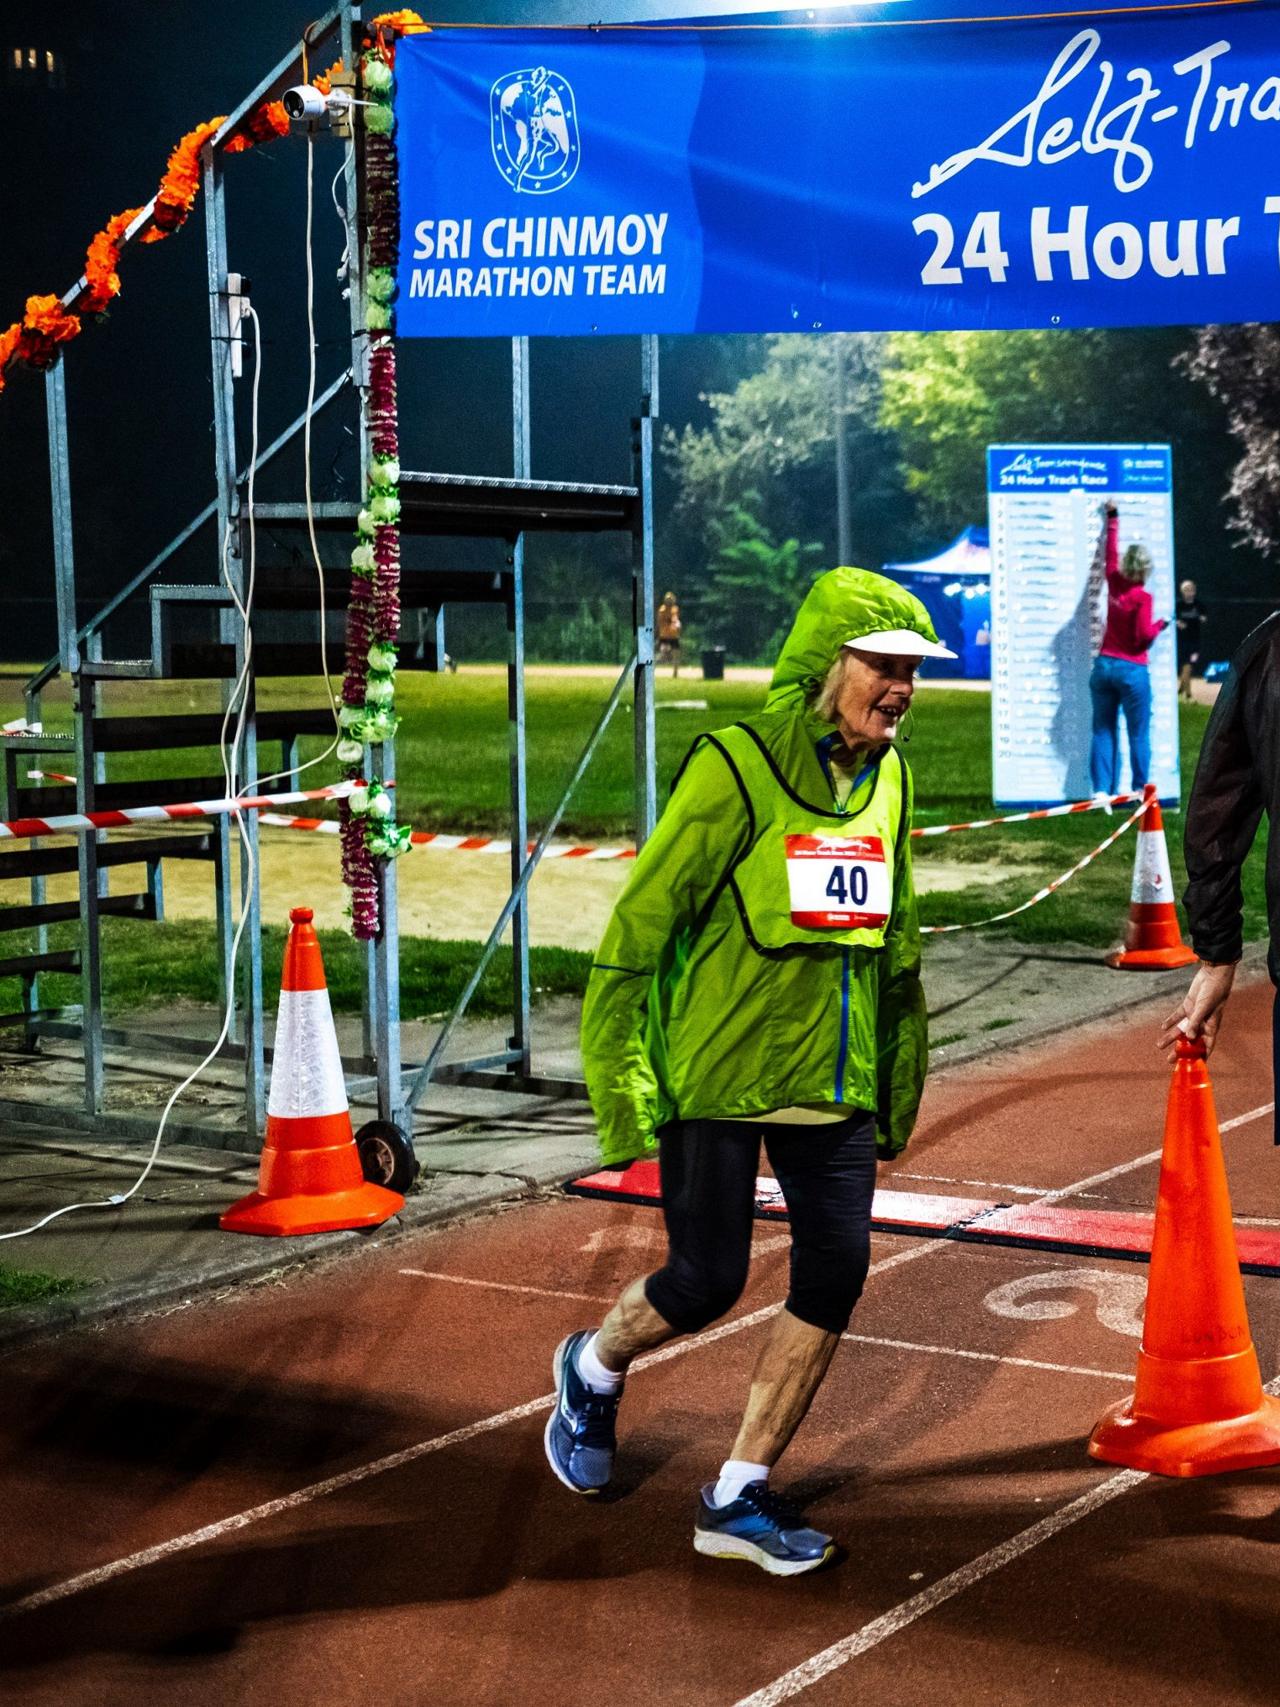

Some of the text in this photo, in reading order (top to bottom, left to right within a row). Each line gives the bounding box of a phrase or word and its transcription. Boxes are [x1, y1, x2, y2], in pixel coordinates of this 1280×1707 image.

[413, 214, 668, 260] SRI CHINMOY
[911, 213, 1010, 285] 24
[1031, 206, 1240, 281] Hour
[409, 265, 667, 298] MARATHON TEAM
[999, 474, 1109, 486] 24 Hour Track Race
[825, 865, 868, 906] 40
